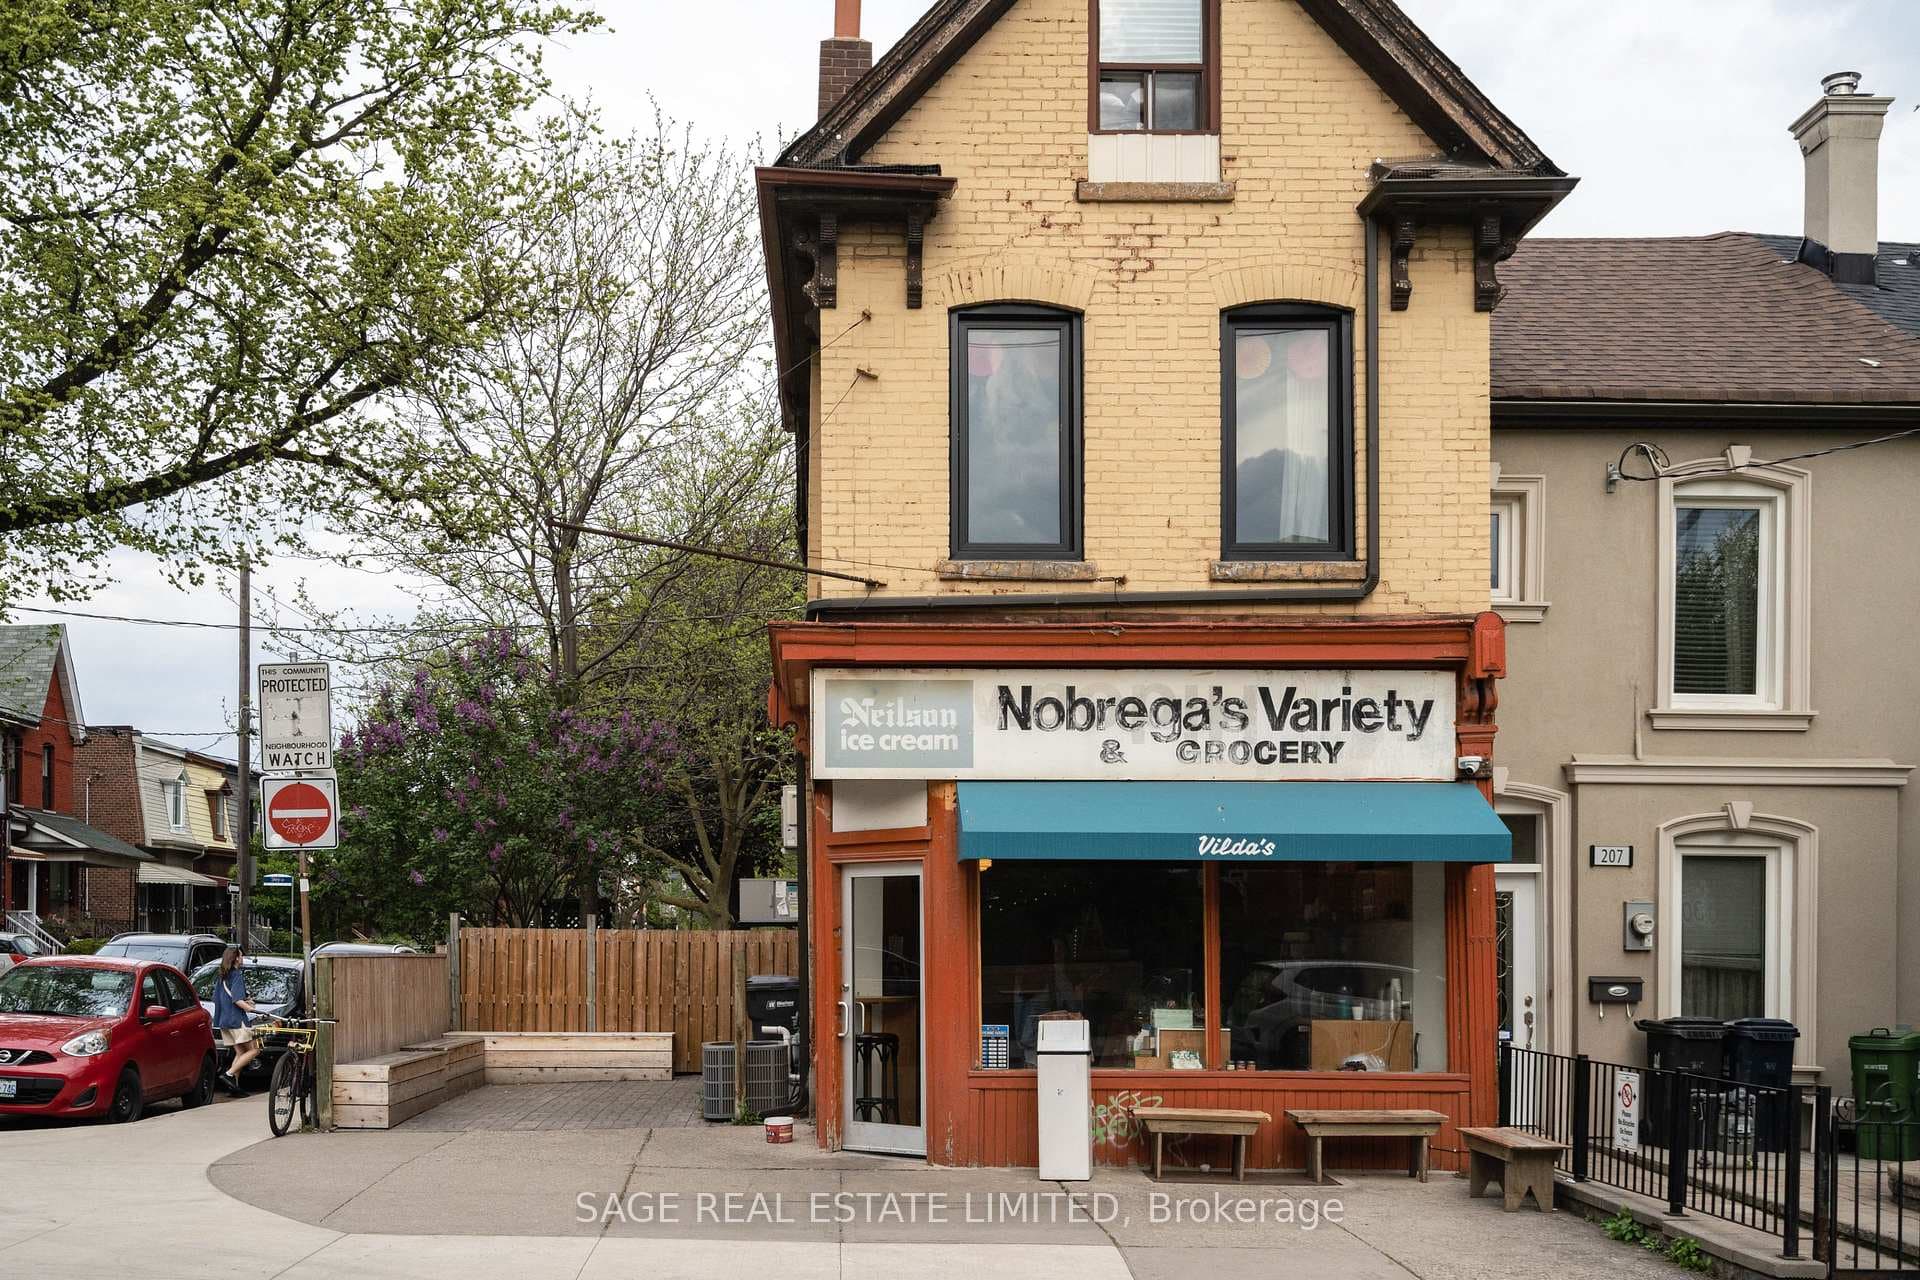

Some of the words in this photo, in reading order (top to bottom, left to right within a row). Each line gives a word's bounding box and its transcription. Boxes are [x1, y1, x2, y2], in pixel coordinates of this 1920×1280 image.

[283, 667, 326, 675] COMMUNITY
[262, 678, 327, 693] PROTECTED
[840, 696, 957, 728] Neilson
[996, 685, 1249, 742] Nobrega's
[1257, 686, 1435, 741] Variety
[265, 741, 328, 750] NEIGHBOURHOOD
[840, 729, 874, 751] ice
[879, 732, 959, 751] cream
[269, 751, 325, 767] WATCH
[1099, 739, 1128, 764] &
[1175, 740, 1345, 765] GROCERY
[1198, 835, 1276, 856] Vilda's
[1601, 849, 1623, 863] 207
